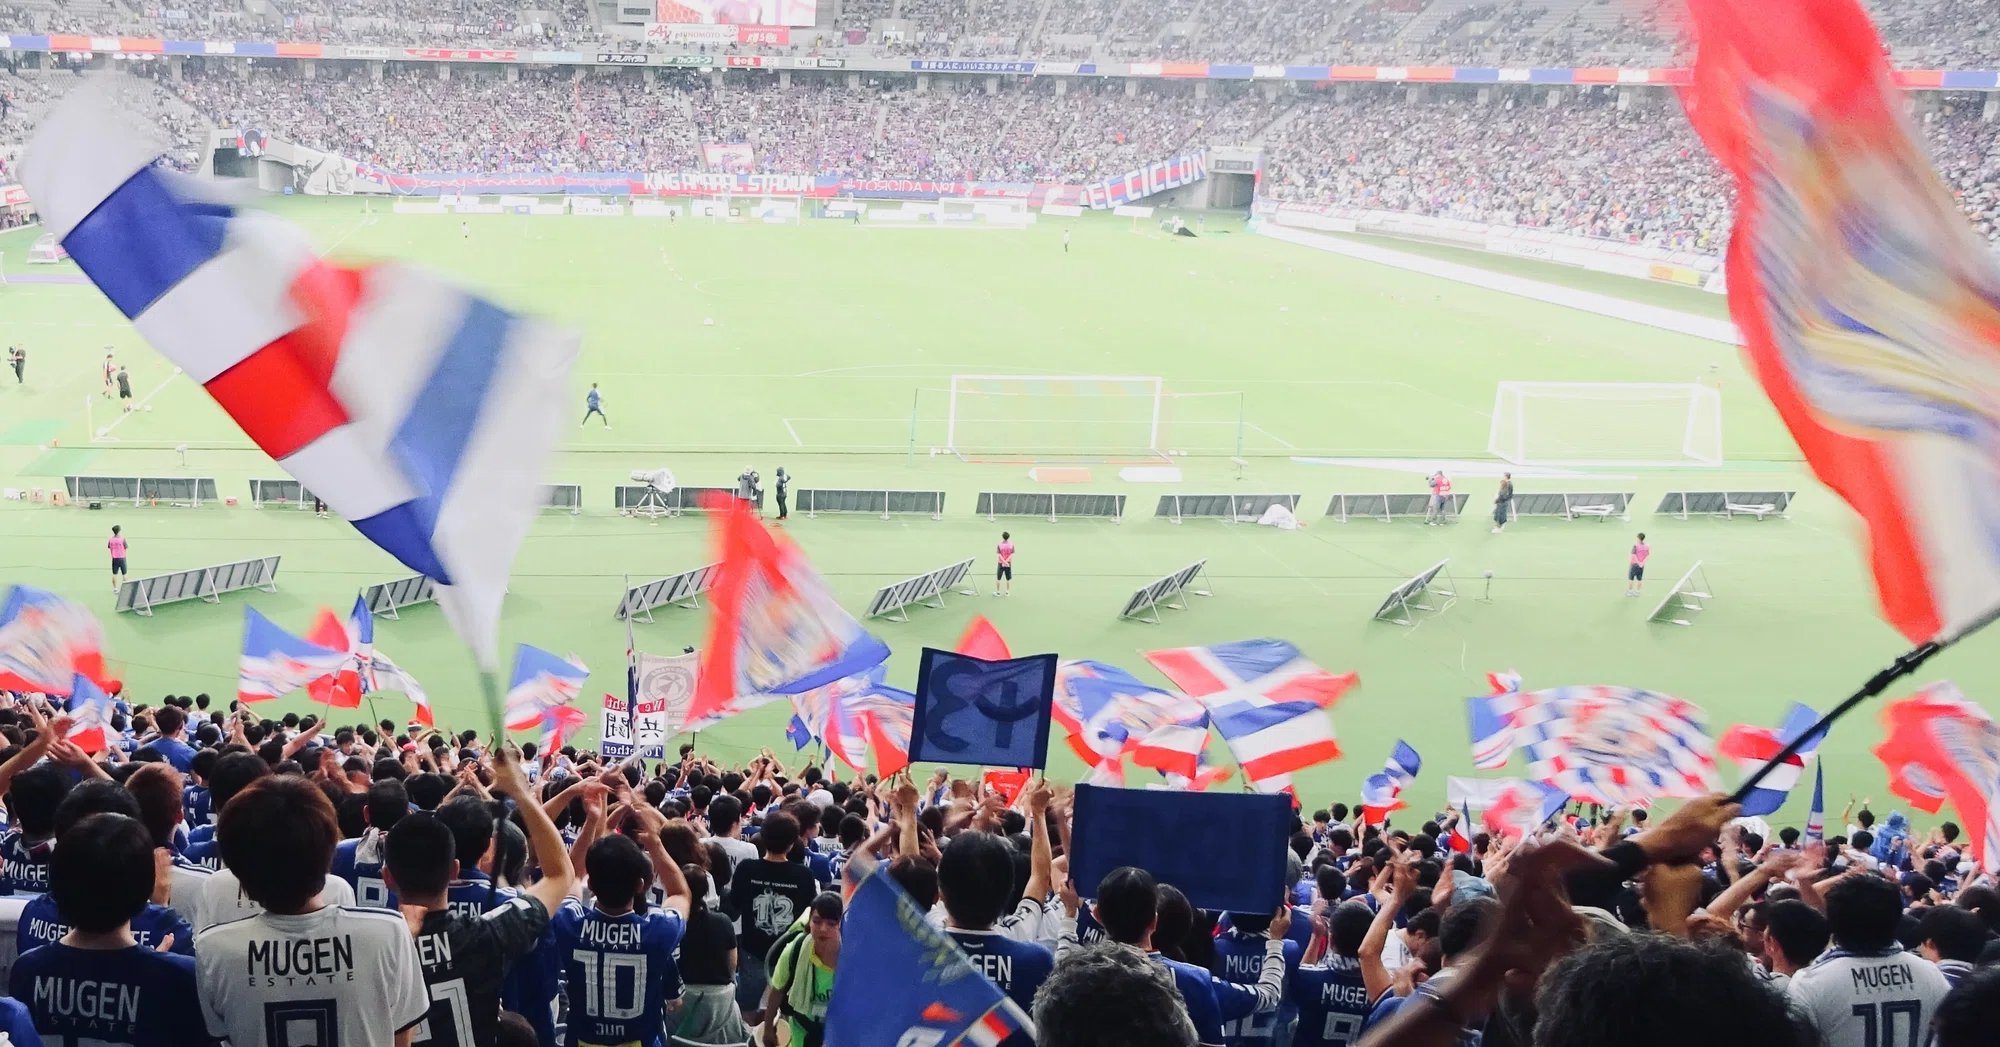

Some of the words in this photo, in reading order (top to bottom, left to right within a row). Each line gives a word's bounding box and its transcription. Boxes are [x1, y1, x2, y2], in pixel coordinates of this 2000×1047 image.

[644, 173, 680, 191] KING
[748, 174, 815, 192] STADIUM
[1086, 181, 1123, 211] EL
[1124, 149, 1207, 201] CICLON
[2, 858, 49, 882] MUGE
[448, 901, 482, 920] GEN
[753, 894, 794, 923] 12
[580, 919, 641, 944] MUGEN
[248, 935, 354, 976] MUGEN
[969, 954, 1012, 982] GEN
[249, 972, 354, 987] ESTATE
[573, 949, 647, 1019] 10
[1851, 964, 1913, 989] MUGEN
[33, 975, 141, 1022] MUGEN
[51, 1016, 137, 1034] STATE
